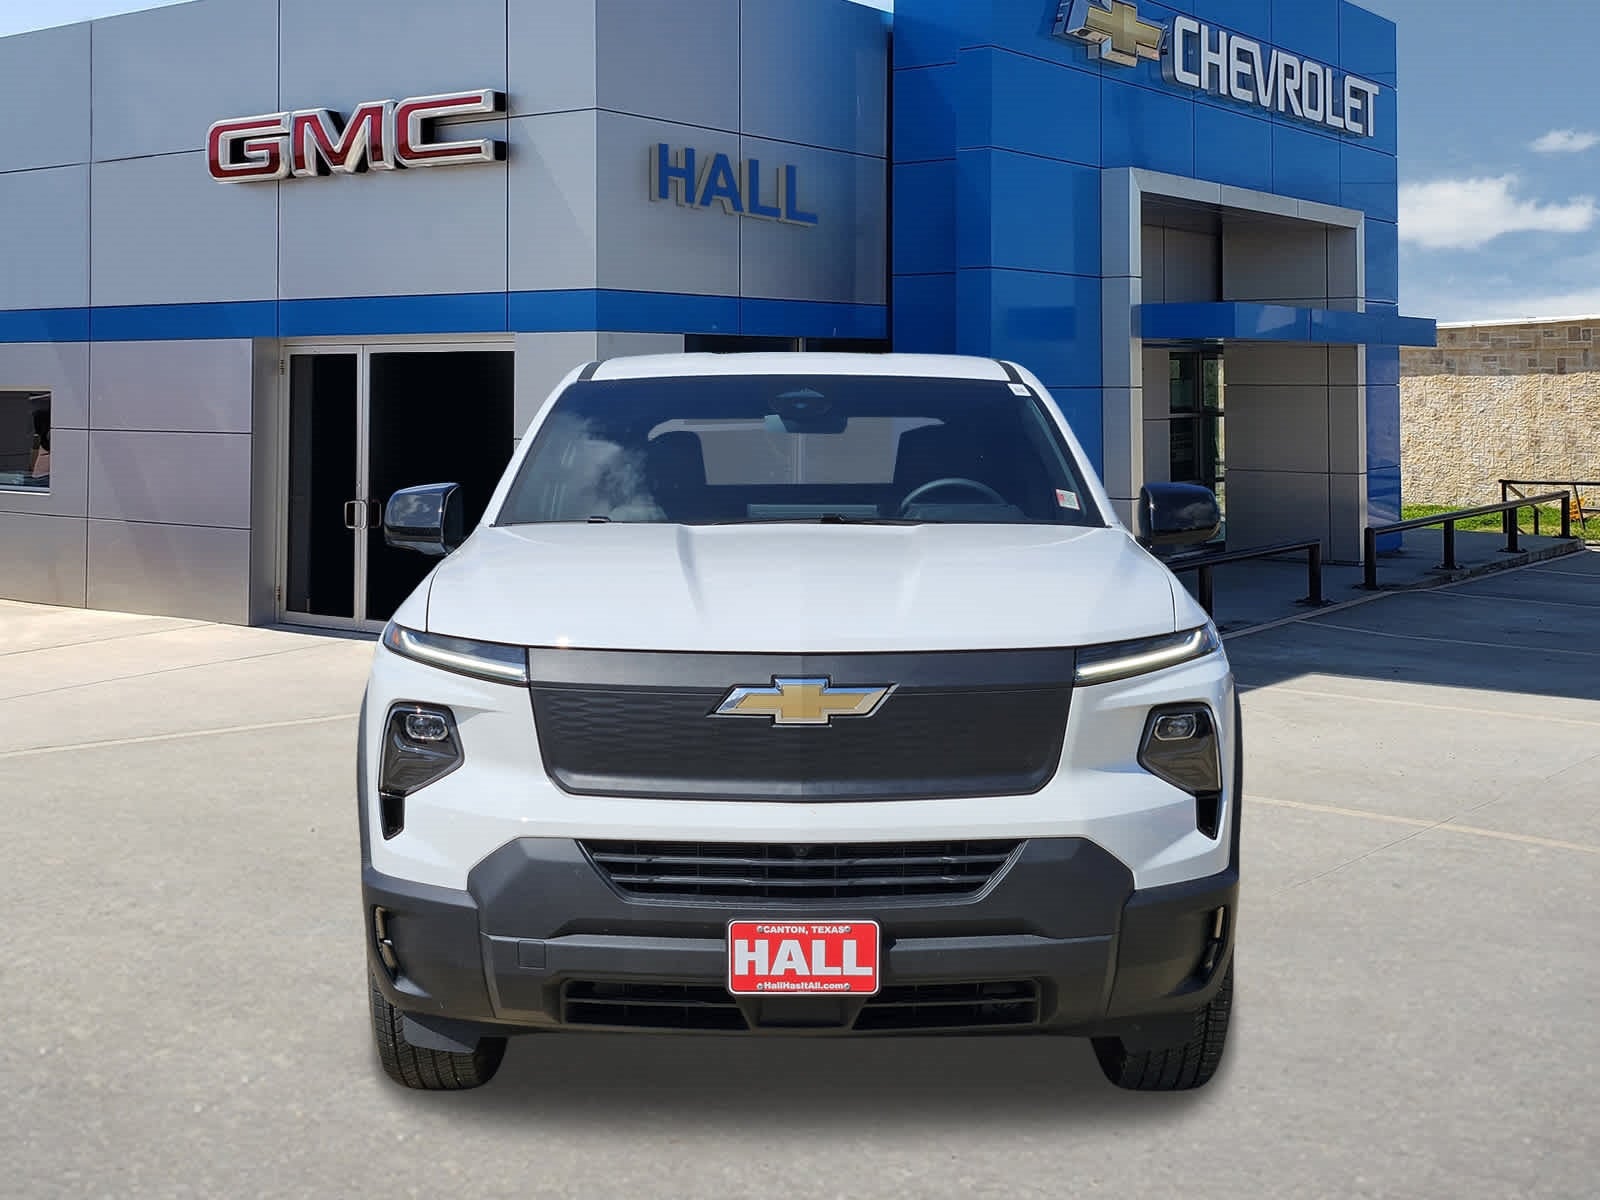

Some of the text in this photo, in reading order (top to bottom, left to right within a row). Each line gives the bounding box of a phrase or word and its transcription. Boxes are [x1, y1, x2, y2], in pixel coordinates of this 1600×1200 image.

[1174, 15, 1380, 137] CHEVROLET
[207, 88, 503, 184] GMC
[653, 143, 819, 226] HALL
[734, 939, 873, 976] HALL
[763, 925, 845, 935] CANTON, TEXAS
[763, 981, 845, 990] HallHasItAll.com
